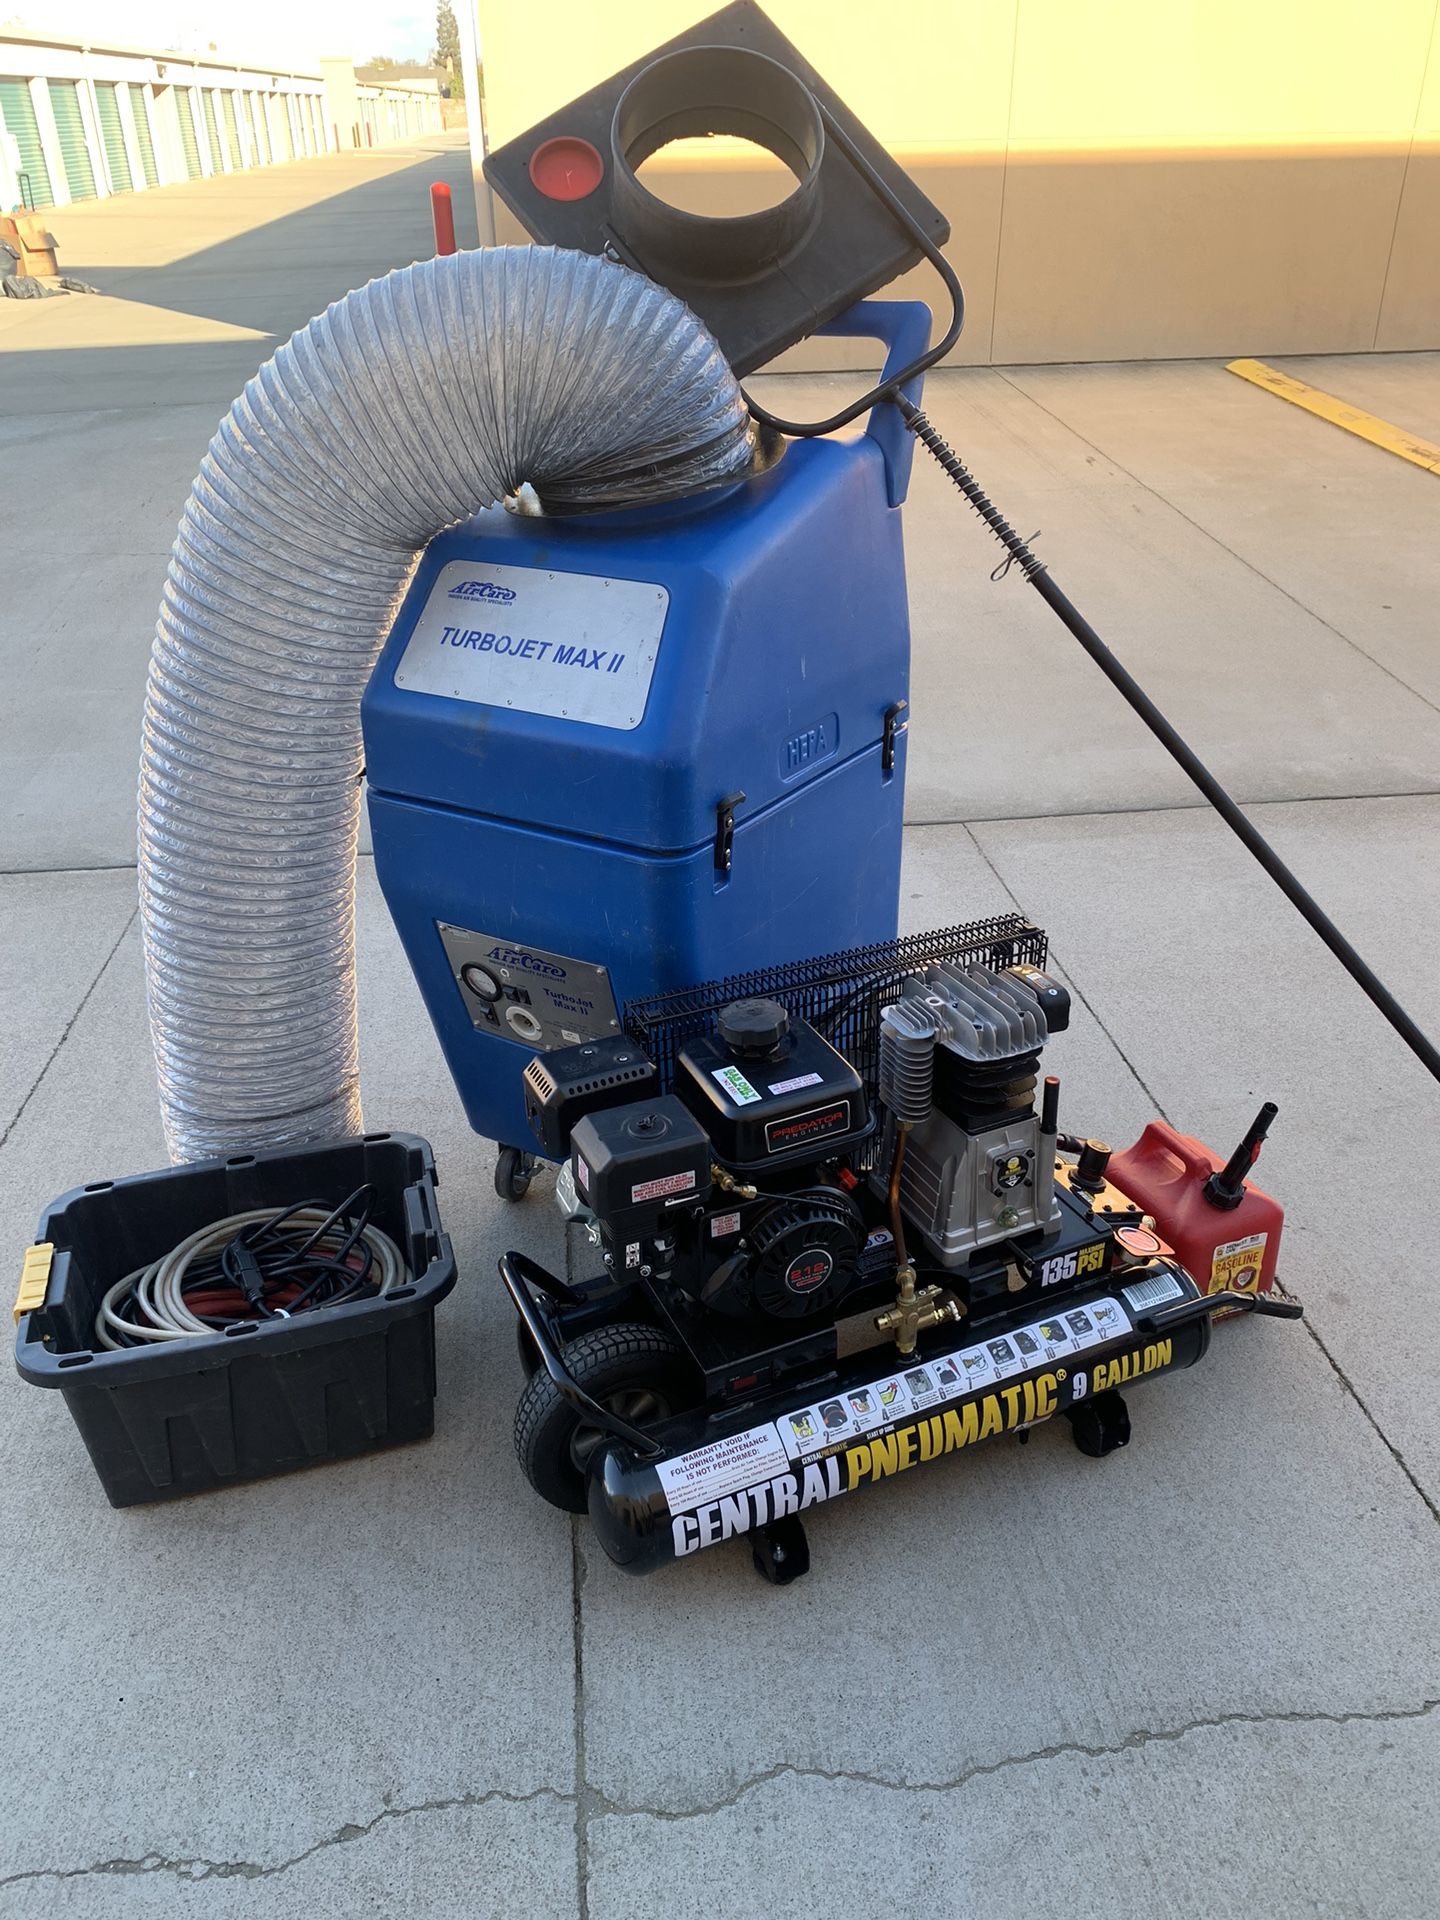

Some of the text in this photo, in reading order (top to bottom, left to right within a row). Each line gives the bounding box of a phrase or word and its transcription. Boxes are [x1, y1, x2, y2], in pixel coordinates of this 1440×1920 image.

[440, 626, 625, 673] TURBOJET MAX II
[787, 724, 827, 768] HEPA
[543, 987, 595, 1009] TurboJet
[554, 1000, 577, 1012] Max
[772, 1111, 844, 1139] PREDATOR
[785, 1122, 833, 1140] ENGINES
[791, 1263, 825, 1280] 212
[1041, 1252, 1078, 1287] 135
[1076, 1248, 1105, 1275] PSI
[1216, 1252, 1259, 1274] GASOLINE
[1097, 1327, 1110, 1341] 12
[1044, 1347, 1056, 1360] 10
[1072, 1338, 1173, 1400] 9 GALLON
[939, 1387, 947, 1400] 6
[965, 1377, 972, 1390] 7
[911, 1397, 919, 1411] 5
[882, 1408, 891, 1421] 4
[853, 1419, 861, 1433] 3
[681, 1432, 751, 1463] WARRANTY VOID IF
[823, 1431, 832, 1444] 2
[670, 1435, 769, 1477] FOLLOWING MAINTENANCE
[686, 1448, 760, 1481] IS NOT PERFORMED:
